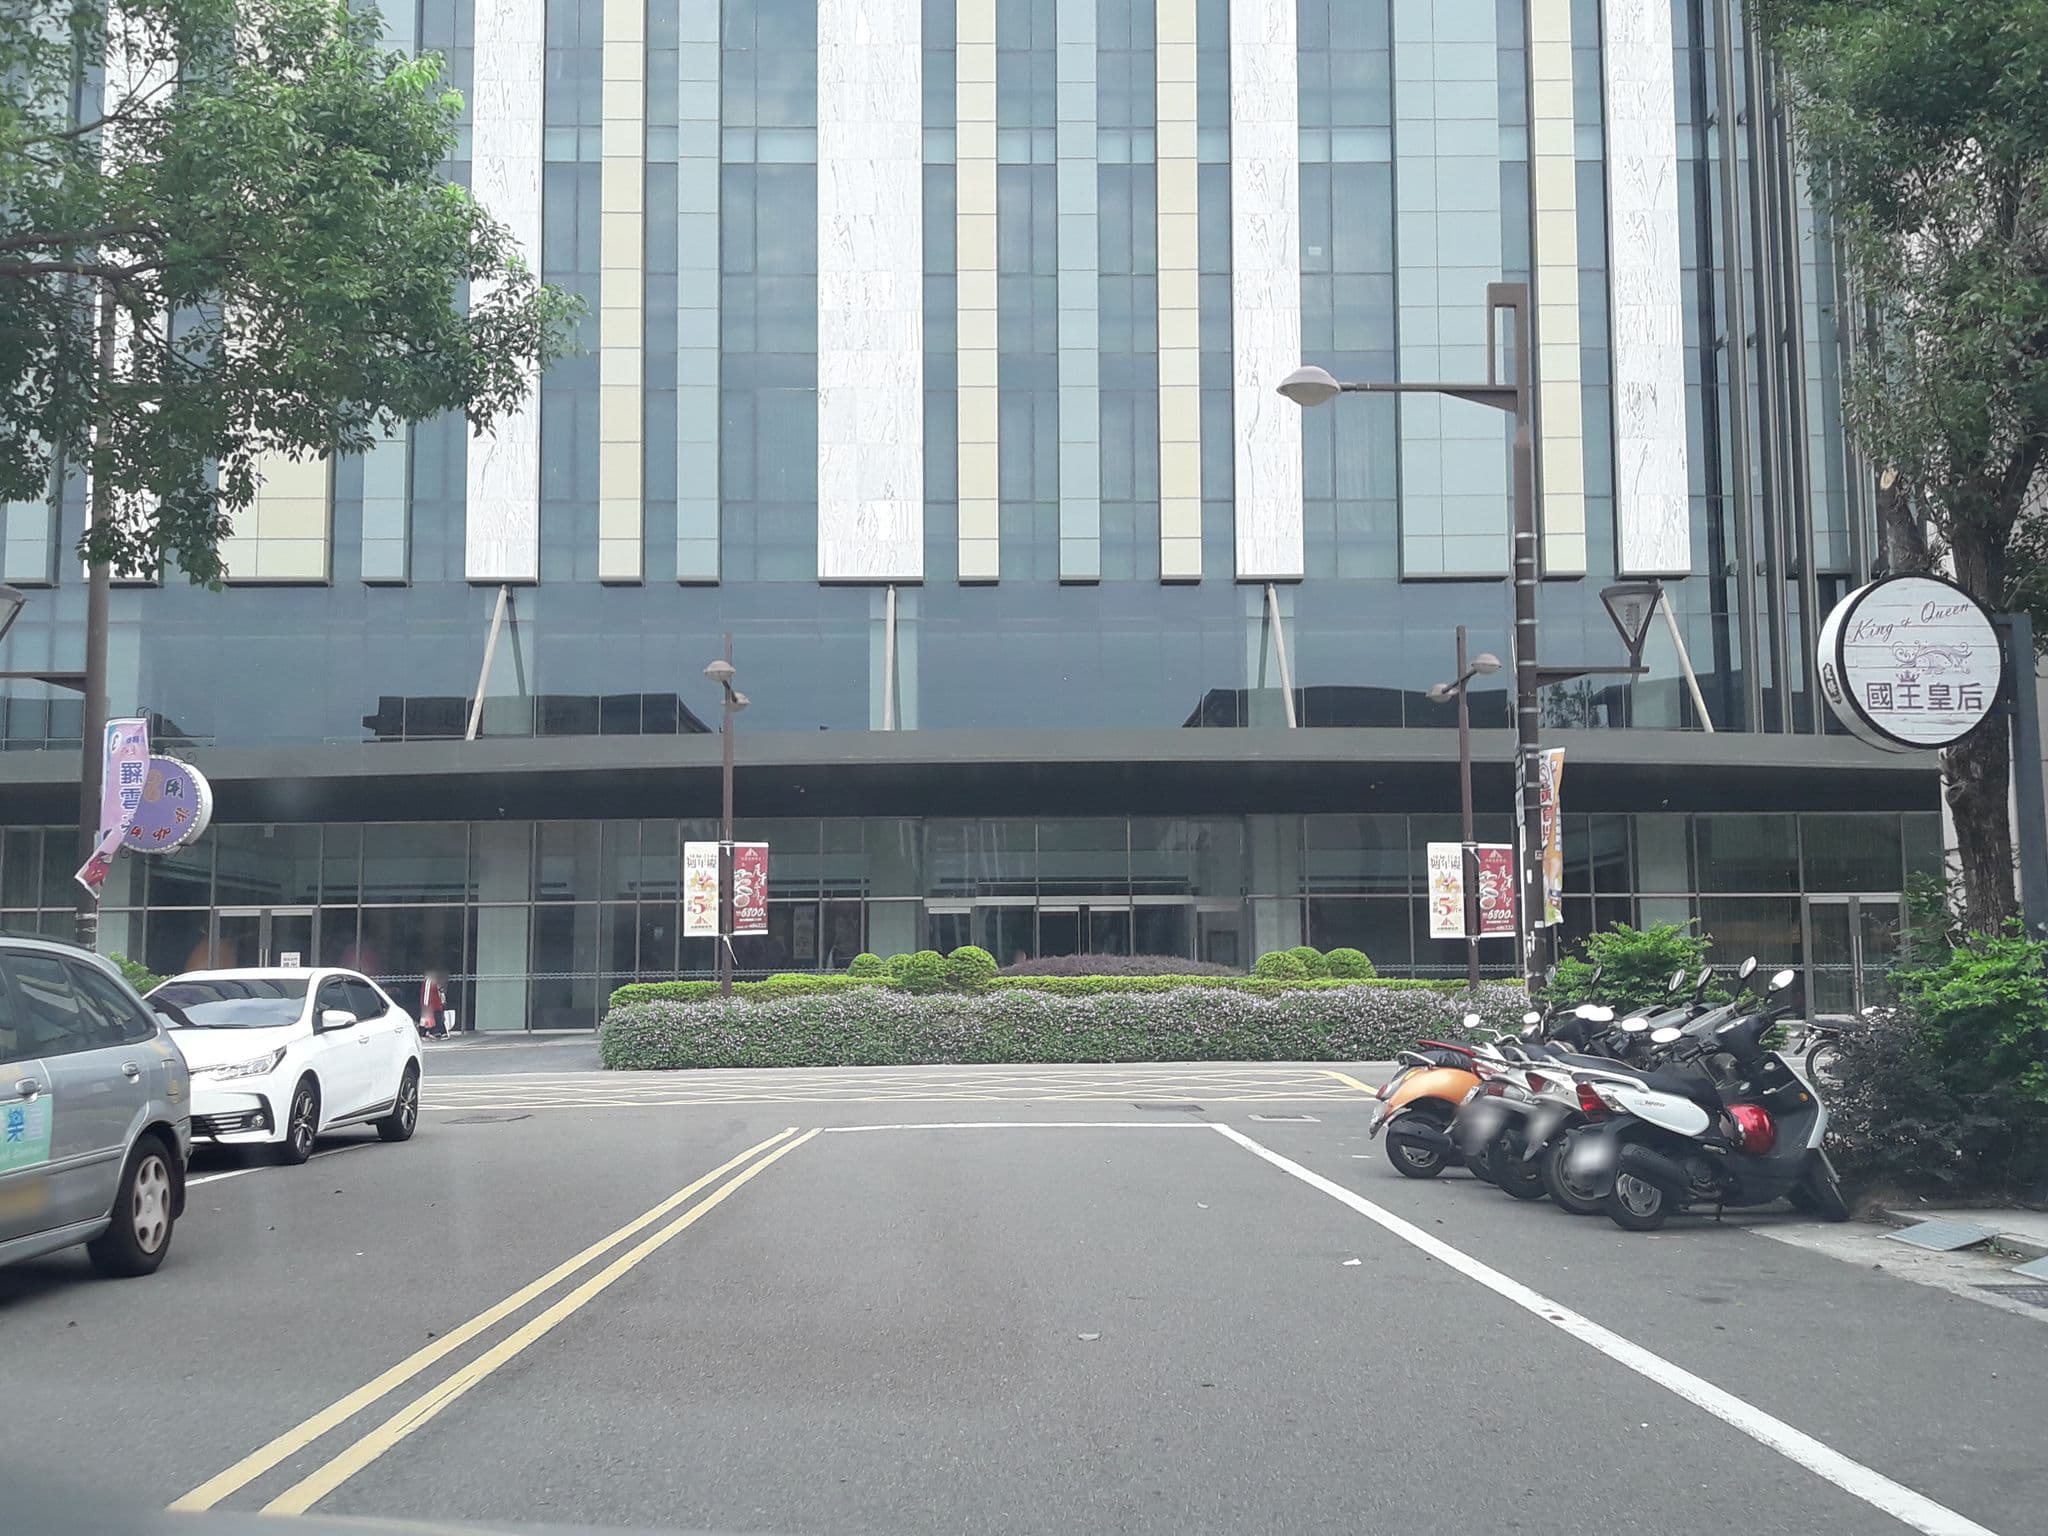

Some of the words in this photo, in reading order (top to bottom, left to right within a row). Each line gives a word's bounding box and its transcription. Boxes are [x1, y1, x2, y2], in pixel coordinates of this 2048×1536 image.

[1852, 618, 1895, 643] King
[1920, 600, 1970, 624] Queen
[1866, 682, 1984, 711] 國王皇后
